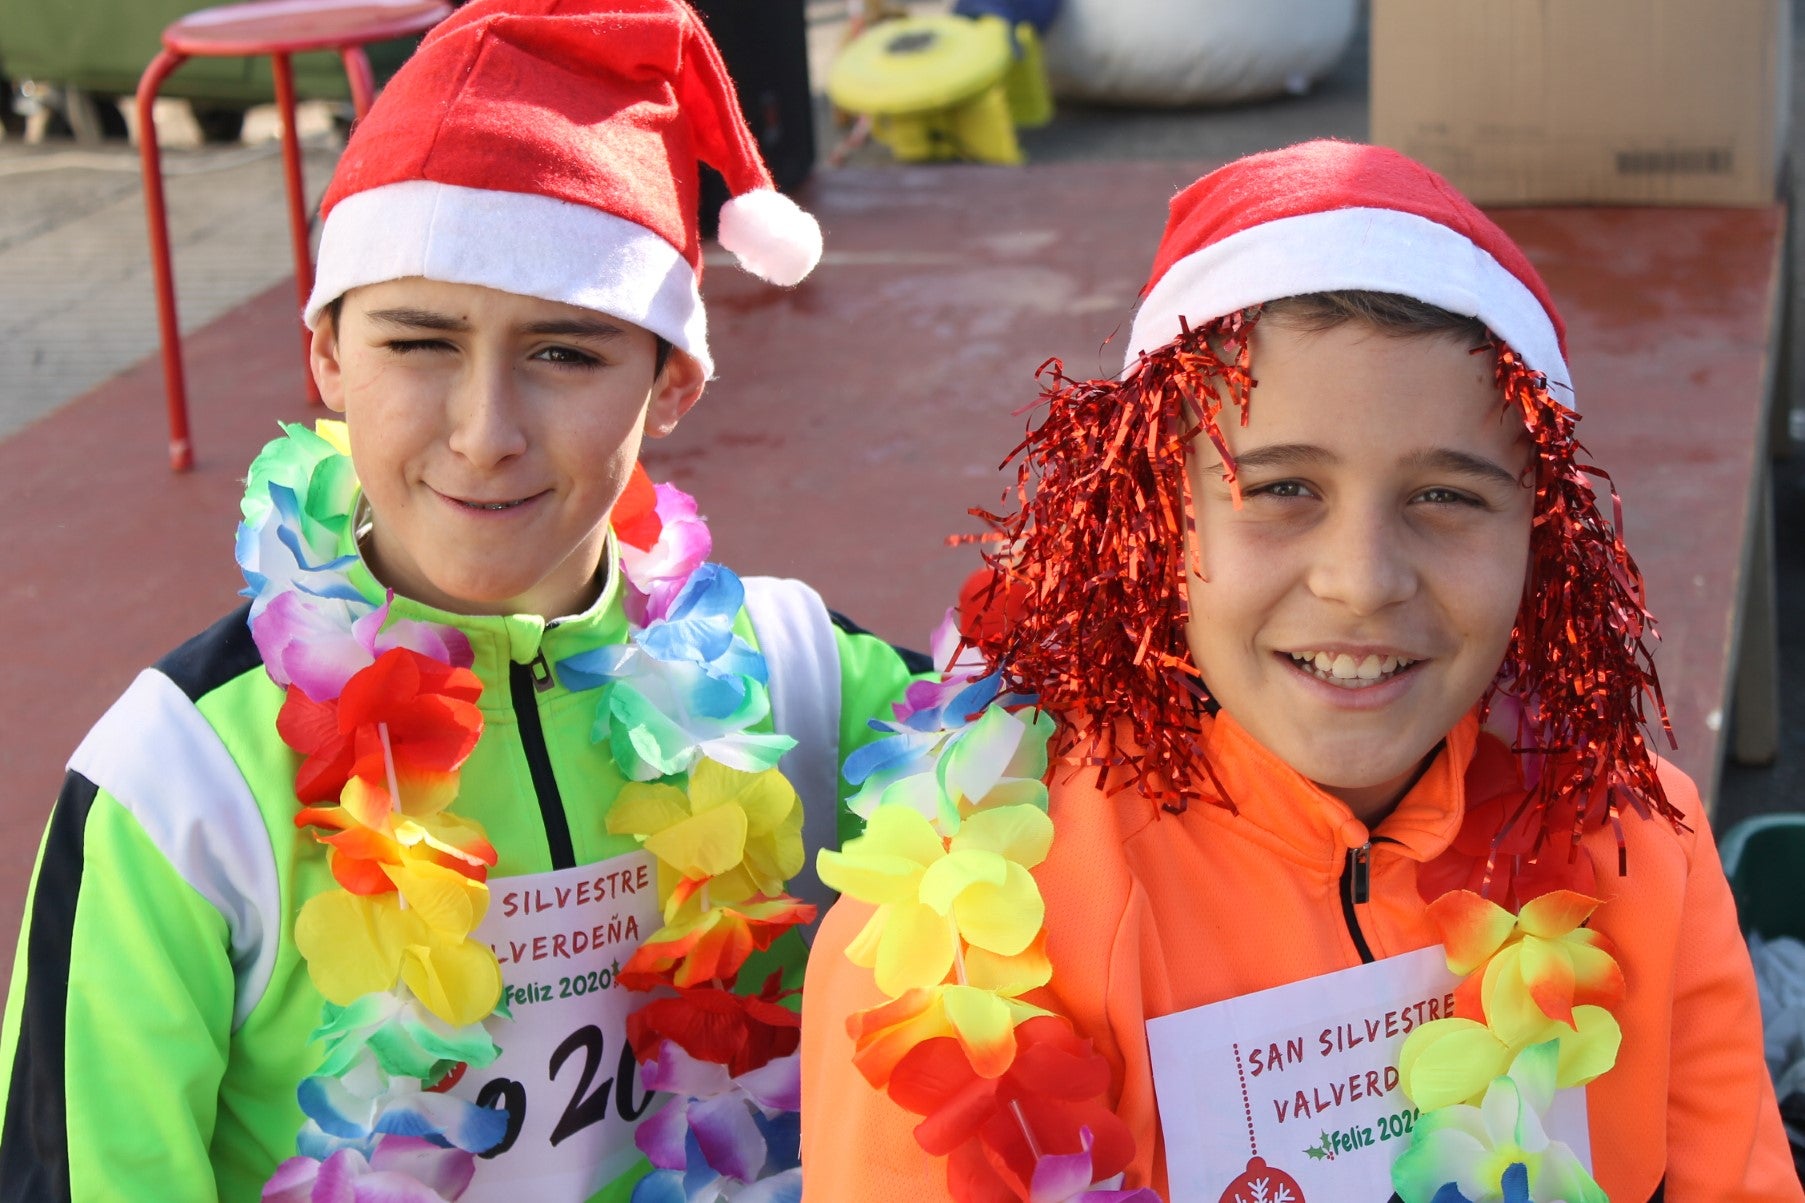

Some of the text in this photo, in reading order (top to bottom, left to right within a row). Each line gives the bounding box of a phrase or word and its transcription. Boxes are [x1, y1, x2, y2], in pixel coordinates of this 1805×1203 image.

[502, 865, 649, 918] SILVESTRE
[505, 968, 611, 1006] Feliz 2020
[1248, 992, 1455, 1077] SAN SILVESTRE
[1331, 1125, 1375, 1155] Feliz
